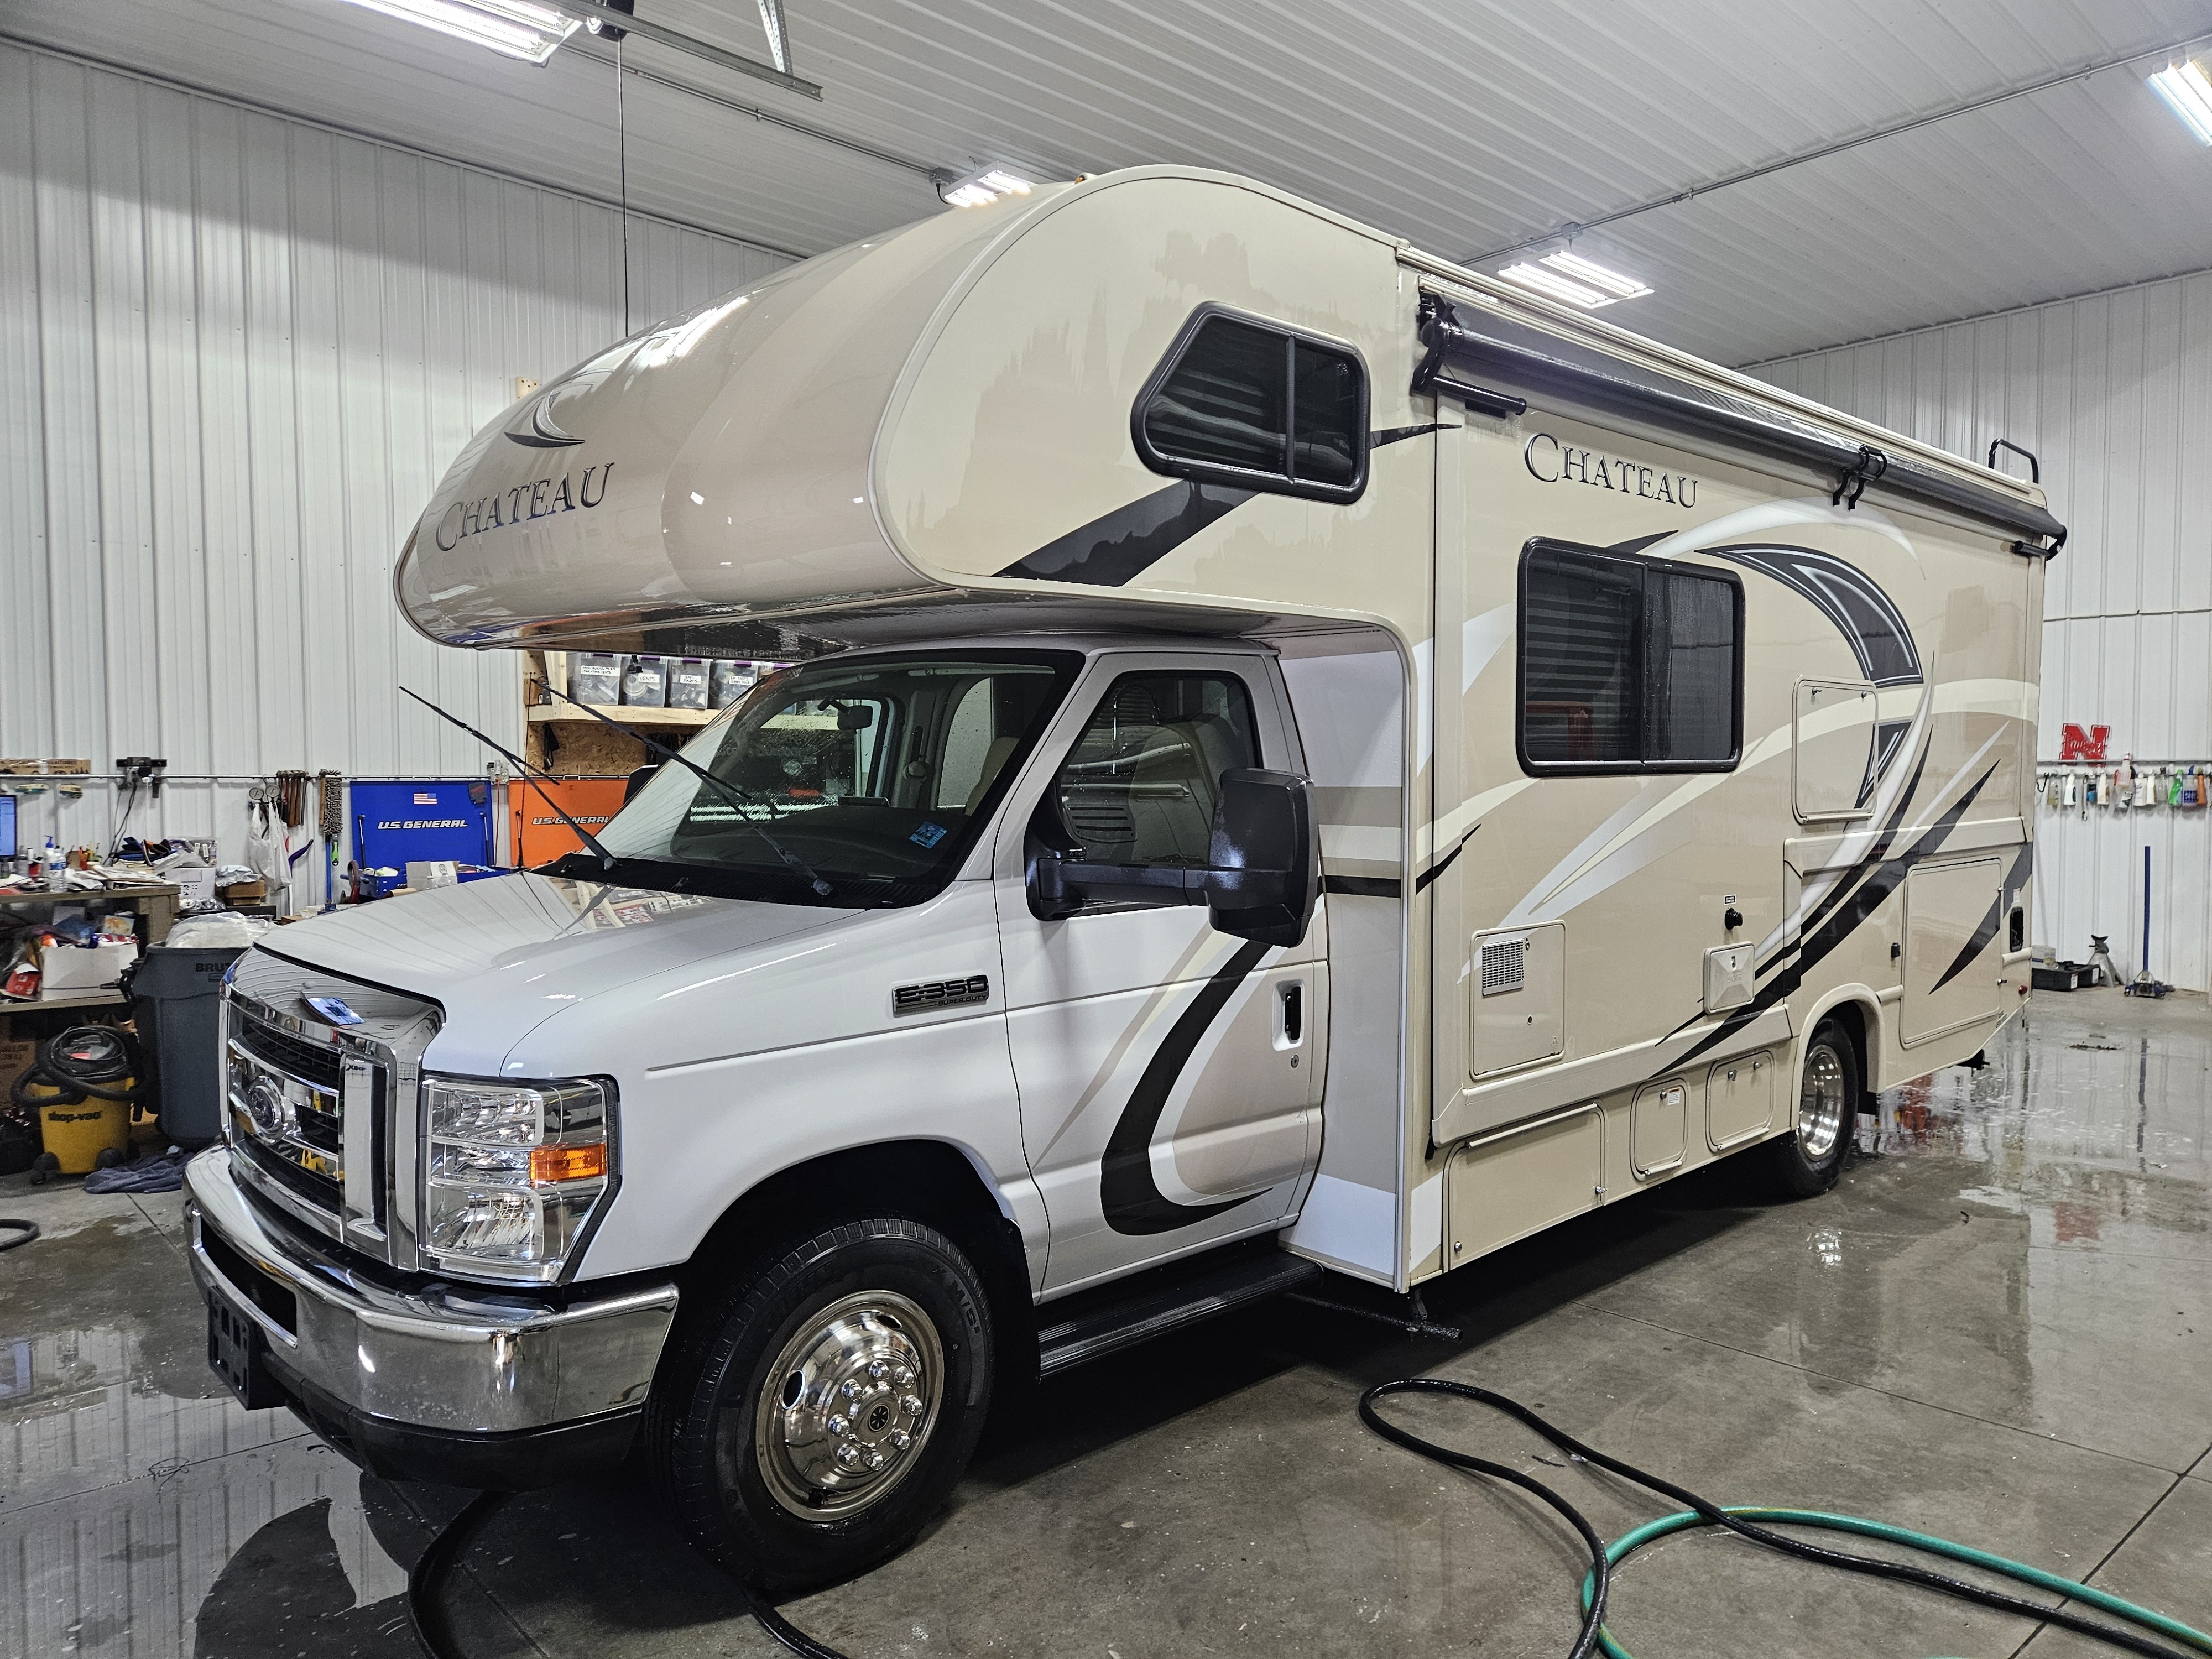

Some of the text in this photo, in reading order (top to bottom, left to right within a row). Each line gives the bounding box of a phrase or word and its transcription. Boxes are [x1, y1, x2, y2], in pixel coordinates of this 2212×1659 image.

[1524, 432, 1698, 508] CHATEAU
[436, 462, 615, 551] CHATEAU
[403, 820, 468, 828] GENERAL
[896, 974, 989, 1004] E-350
[937, 994, 987, 1006] SUPER DUTY
